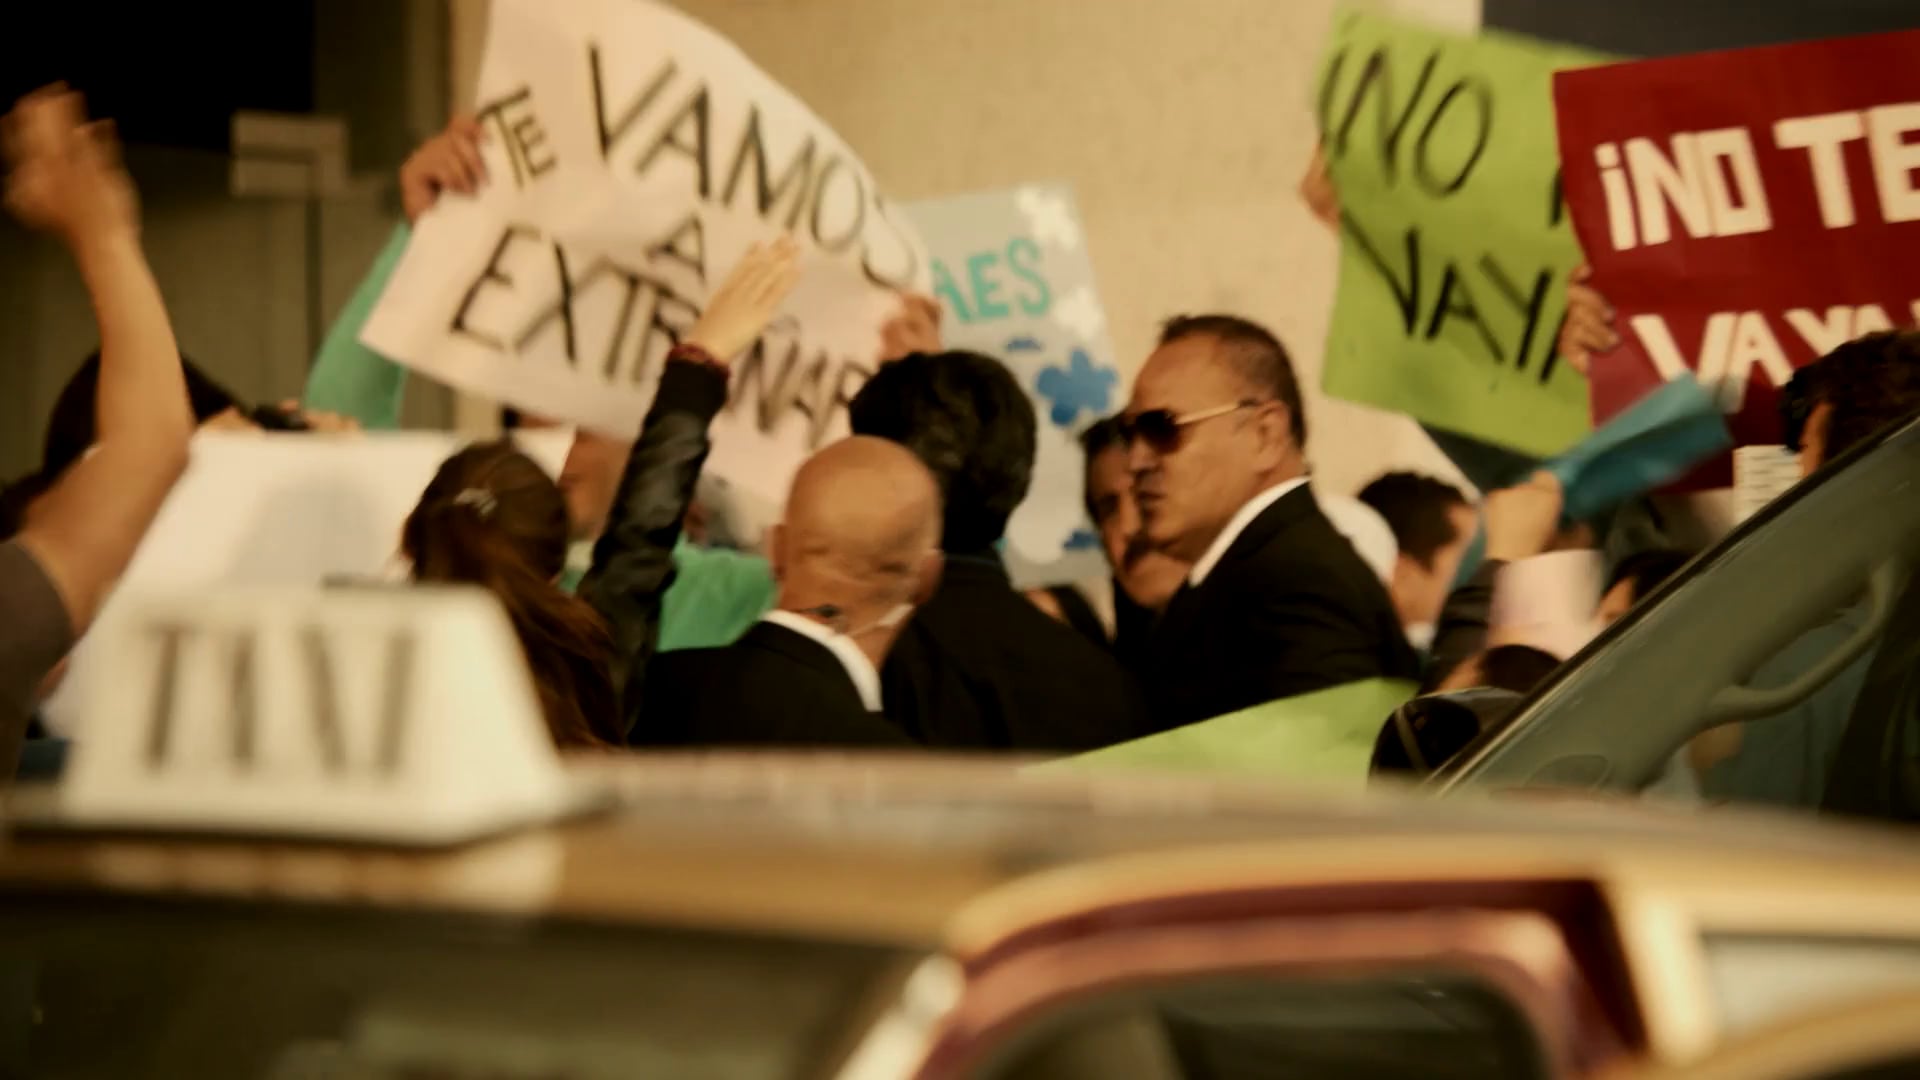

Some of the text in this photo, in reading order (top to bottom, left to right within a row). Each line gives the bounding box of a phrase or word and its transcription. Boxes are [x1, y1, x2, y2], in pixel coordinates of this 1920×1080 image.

[478, 42, 921, 291] TE VAMOS
[645, 210, 706, 286] A
[1338, 205, 1570, 386] VAY
